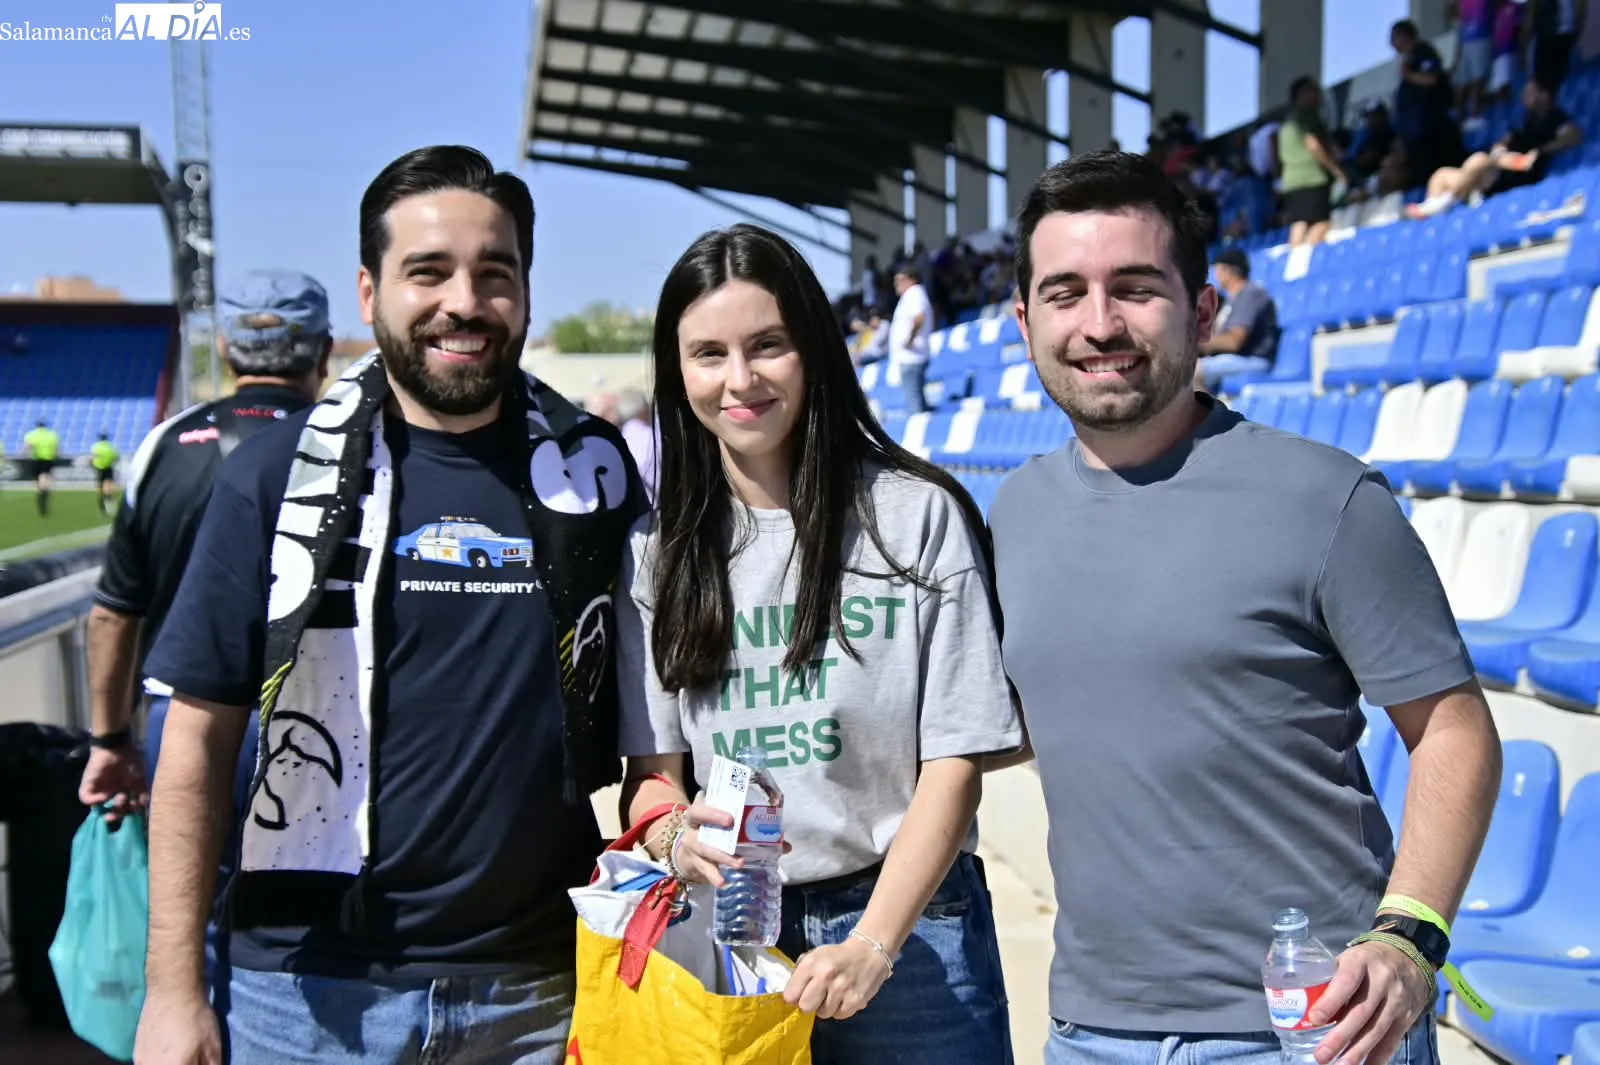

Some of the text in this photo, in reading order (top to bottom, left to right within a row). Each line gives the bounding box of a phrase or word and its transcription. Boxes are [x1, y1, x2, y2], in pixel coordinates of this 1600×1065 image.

[400, 580, 534, 594] PRIVATE SECURITY
[720, 657, 838, 712] THAT
[711, 717, 843, 768] MESS
